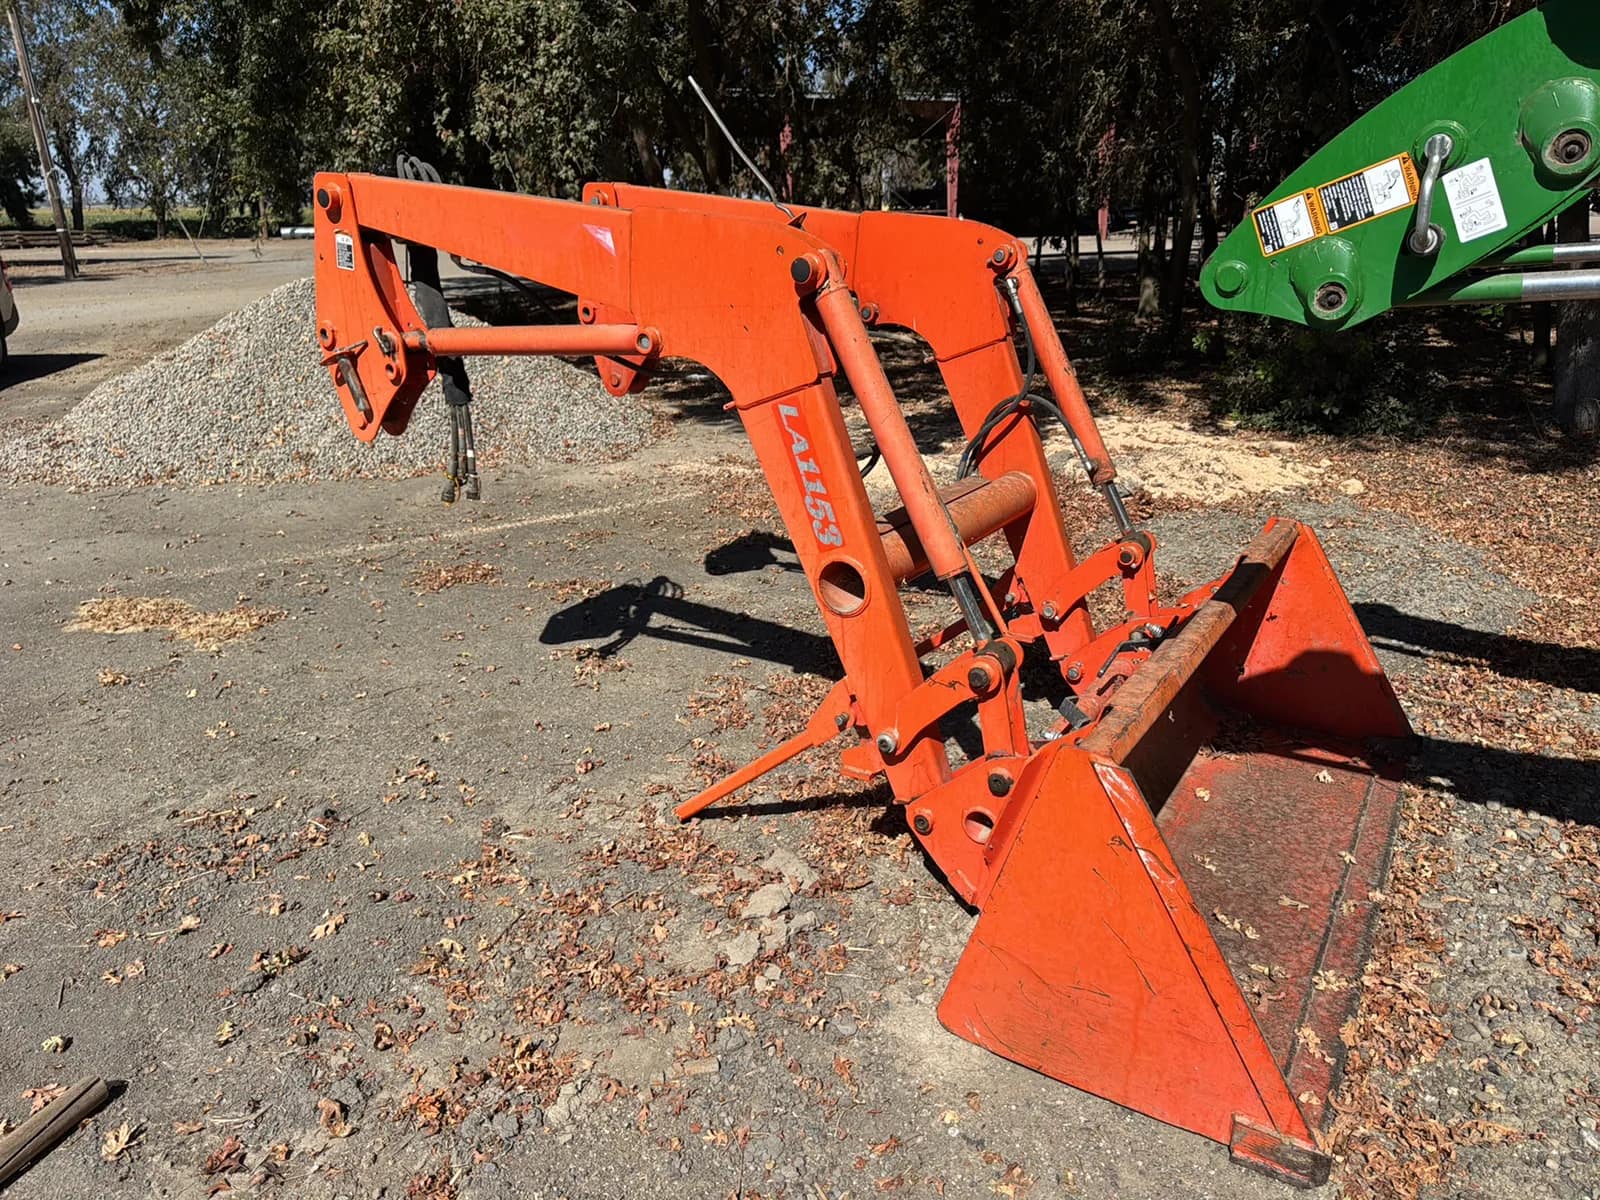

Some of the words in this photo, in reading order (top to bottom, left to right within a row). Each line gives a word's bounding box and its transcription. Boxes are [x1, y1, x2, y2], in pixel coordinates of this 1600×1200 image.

[1403, 166, 1417, 200] WARNING
[1308, 201, 1322, 234] WARNING
[777, 403, 844, 546] LA1153
